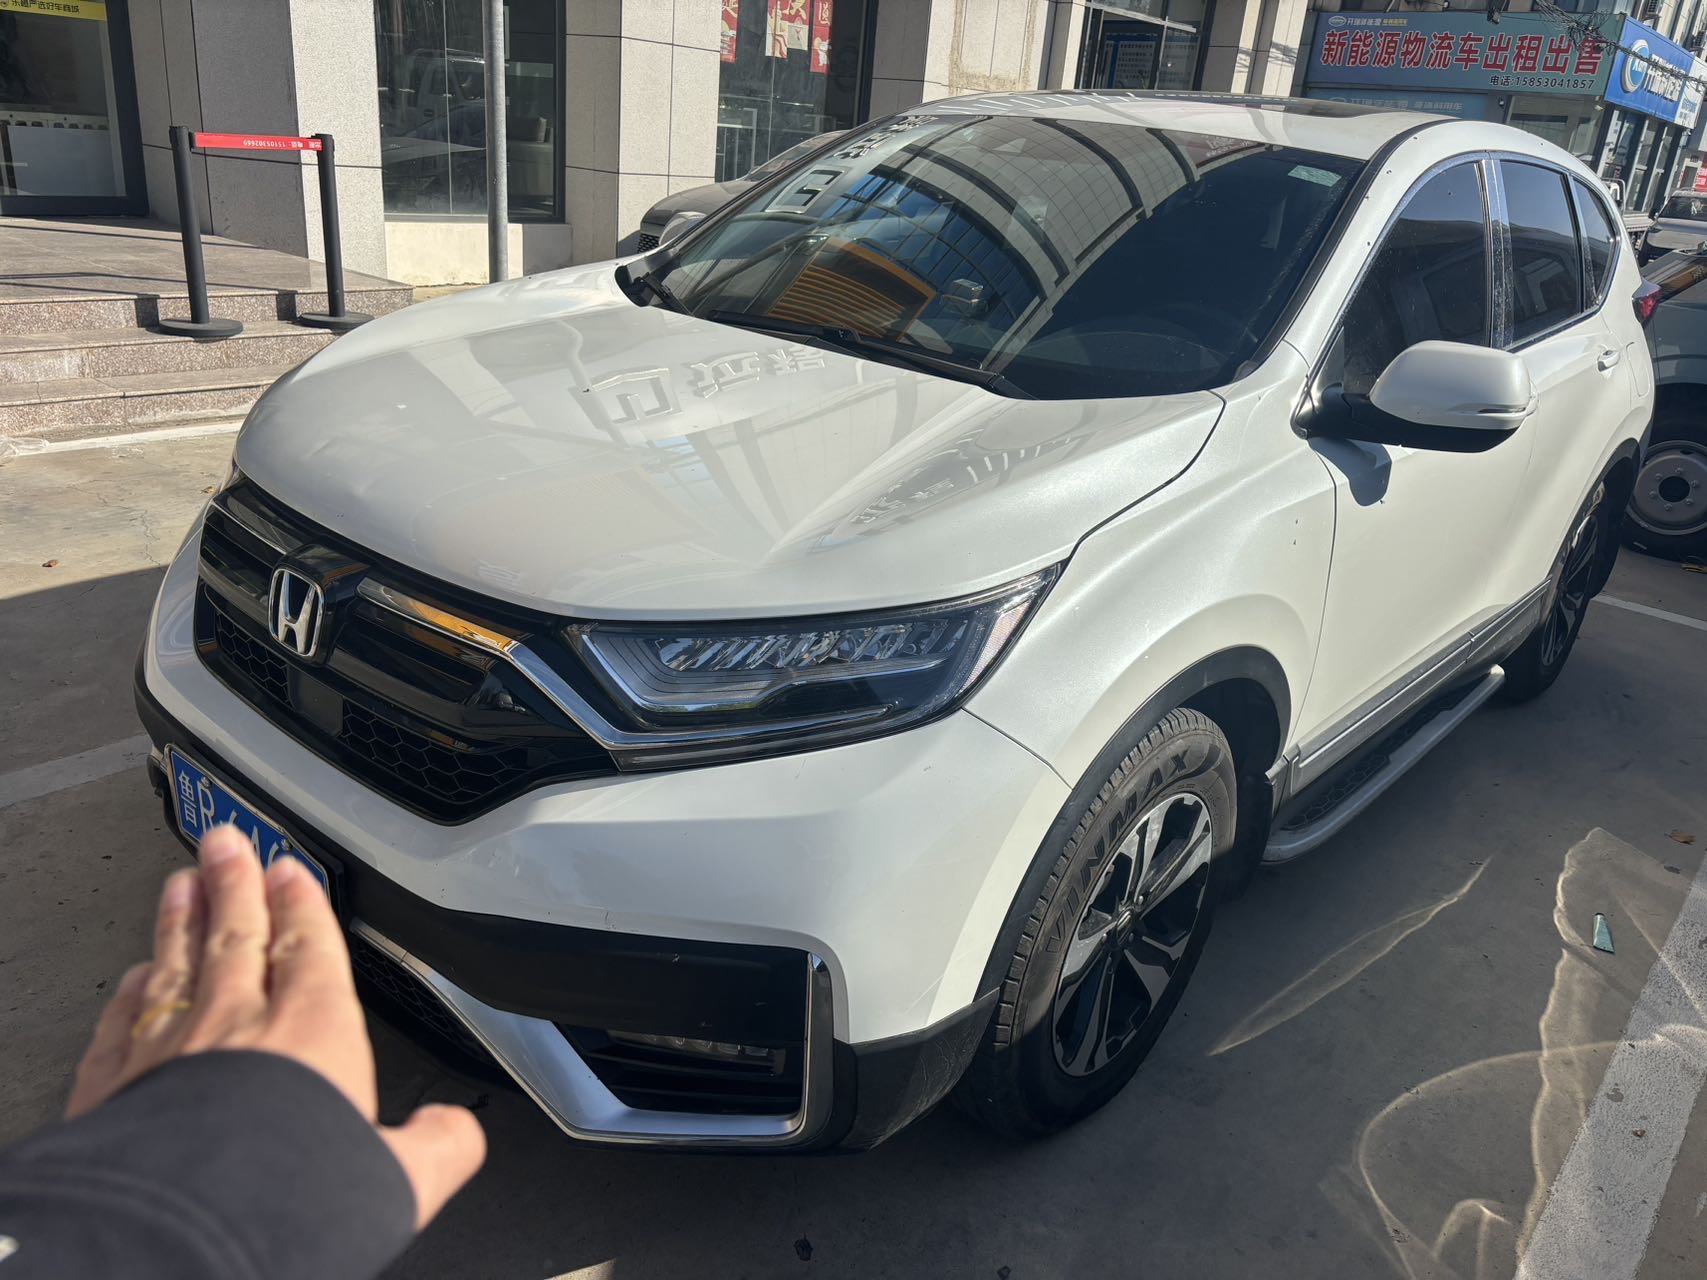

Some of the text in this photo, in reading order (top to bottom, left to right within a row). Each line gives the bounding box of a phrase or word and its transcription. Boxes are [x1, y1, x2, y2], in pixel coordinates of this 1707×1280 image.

[1321, 30, 1604, 76] 新能源物流车出租出售
